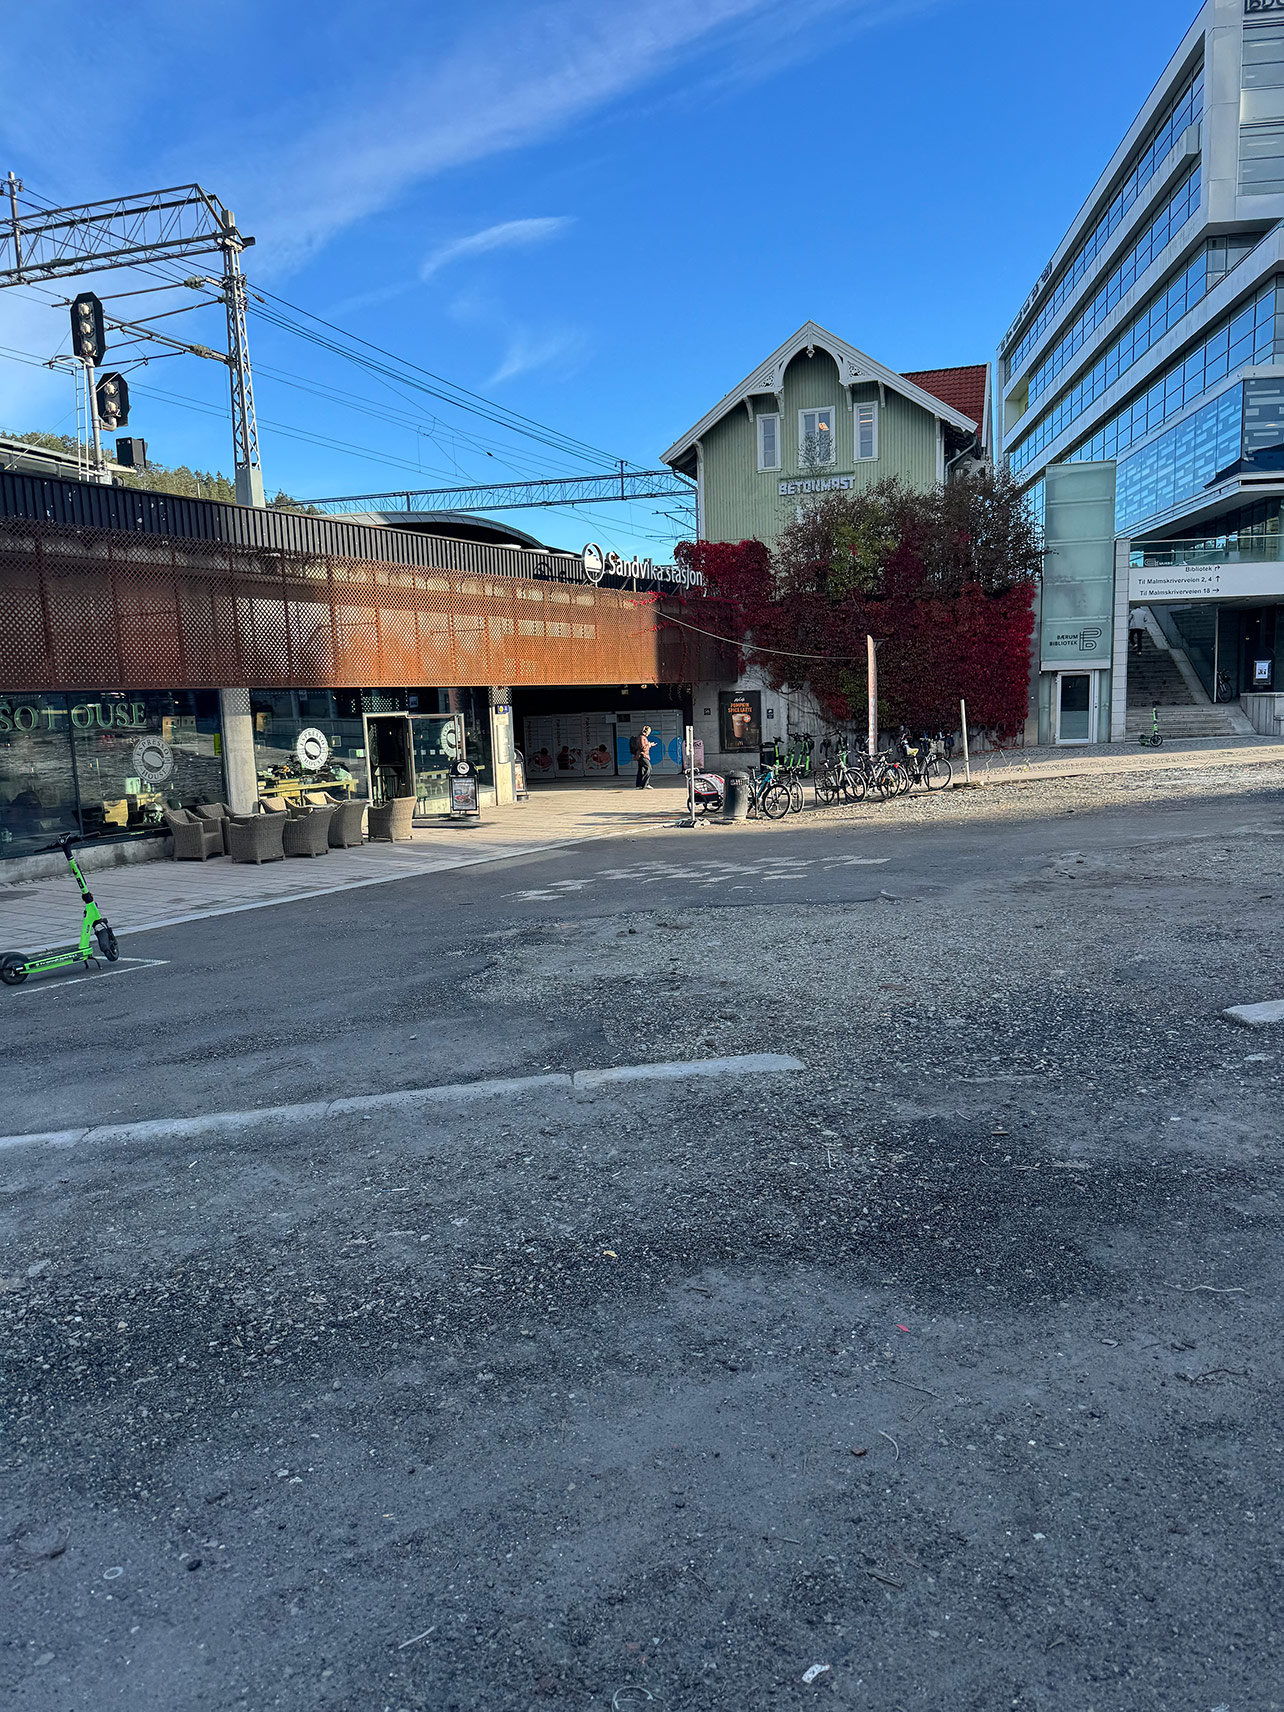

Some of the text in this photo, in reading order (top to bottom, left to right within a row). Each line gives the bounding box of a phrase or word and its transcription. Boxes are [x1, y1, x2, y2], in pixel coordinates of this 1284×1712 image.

[778, 476, 855, 496] BETONMAST
[608, 551, 703, 590] Sandvika stasjon
[136, 738, 171, 757] ESPRESSO
[140, 767, 168, 780] HOUSE
